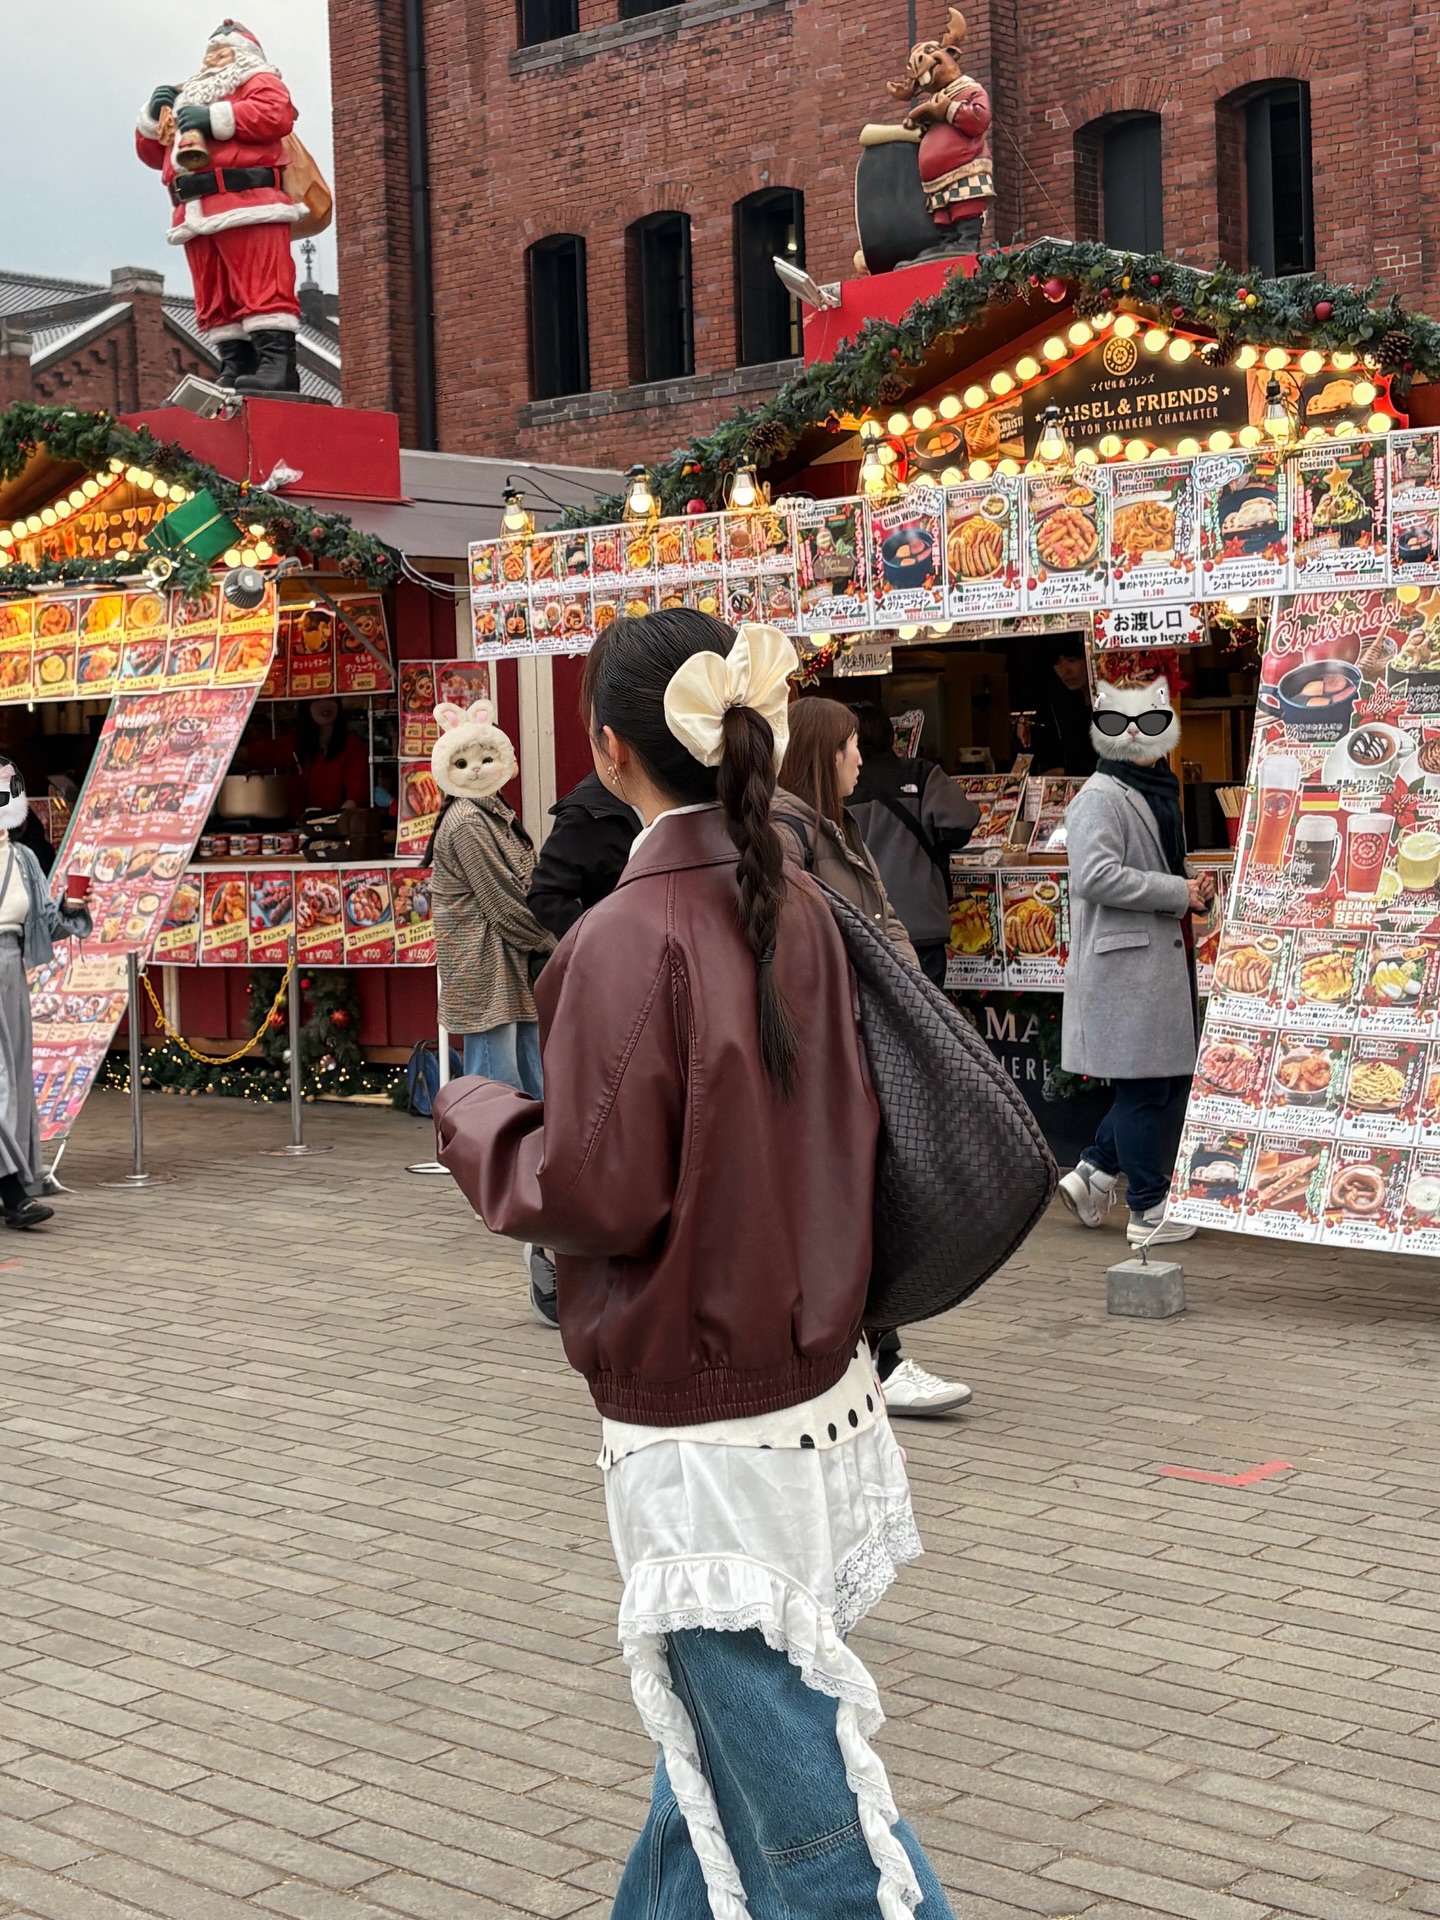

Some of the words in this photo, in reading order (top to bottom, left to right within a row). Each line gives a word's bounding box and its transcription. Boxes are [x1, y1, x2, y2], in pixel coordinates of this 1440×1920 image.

[1118, 399, 1131, 415] &
[1136, 385, 1219, 413] FRIENDS
[1063, 424, 1075, 438] RE
[1081, 422, 1101, 436] VON
[1106, 413, 1152, 433] STARKEM
[1158, 406, 1219, 426] CHARAKTER
[1114, 610, 1182, 632] お渡し口
[1270, 602, 1402, 657] Christmas!
[1111, 634, 1138, 646] Pick
[1142, 634, 1158, 645] up
[1160, 632, 1188, 644] here
[1335, 900, 1378, 912] GERMAN
[1335, 911, 1374, 926] BEER
